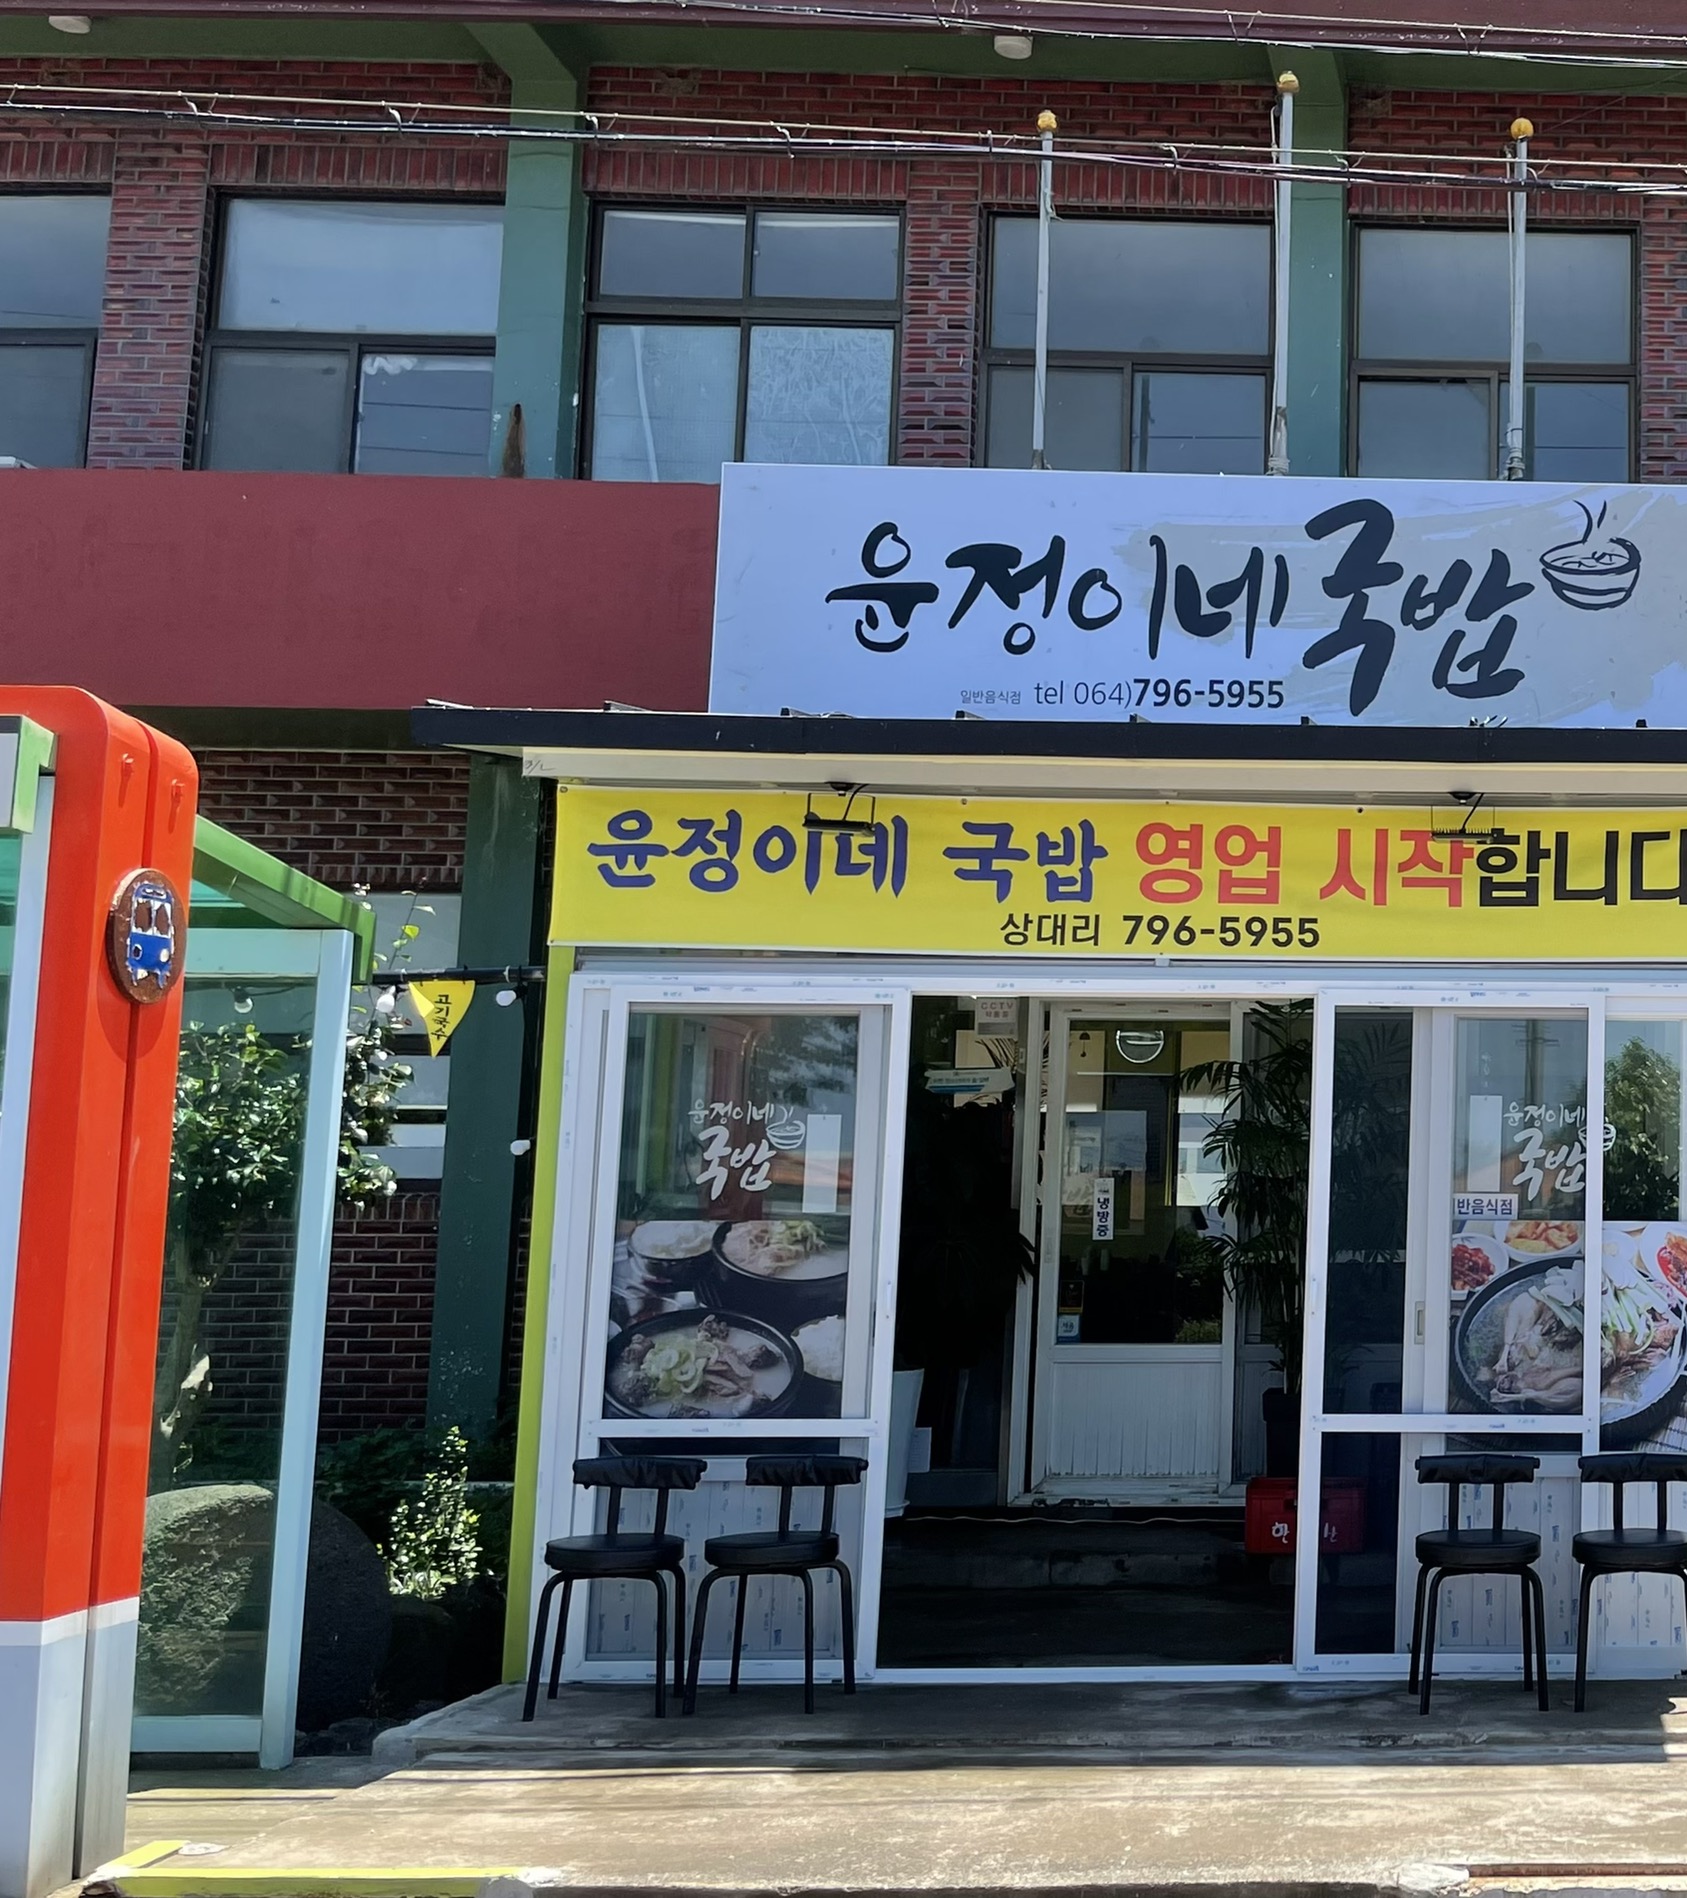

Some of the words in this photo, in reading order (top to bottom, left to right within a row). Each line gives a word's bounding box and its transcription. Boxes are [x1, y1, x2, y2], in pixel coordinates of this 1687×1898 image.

[825, 521, 1289, 661] 윤정이네
[1302, 499, 1536, 718] 국밥
[960, 689, 1022, 705] 일반음식점
[1033, 680, 1065, 705] tel
[586, 808, 908, 898] 윤정이네
[941, 820, 1109, 904] 국밥
[1134, 822, 1281, 906] 영업
[999, 913, 1103, 948] 상대리
[1121, 914, 1321, 950] 796-5955
[980, 1001, 1014, 1010] CCTV
[688, 1098, 775, 1125] 윤정이네
[1503, 1101, 1586, 1128] 윤정이네
[695, 1125, 777, 1201] 국밥
[1512, 1127, 1588, 1202] 국밥
[1096, 1196, 1110, 1237] 냉방중
[1453, 1197, 1513, 1216] 반음식점
